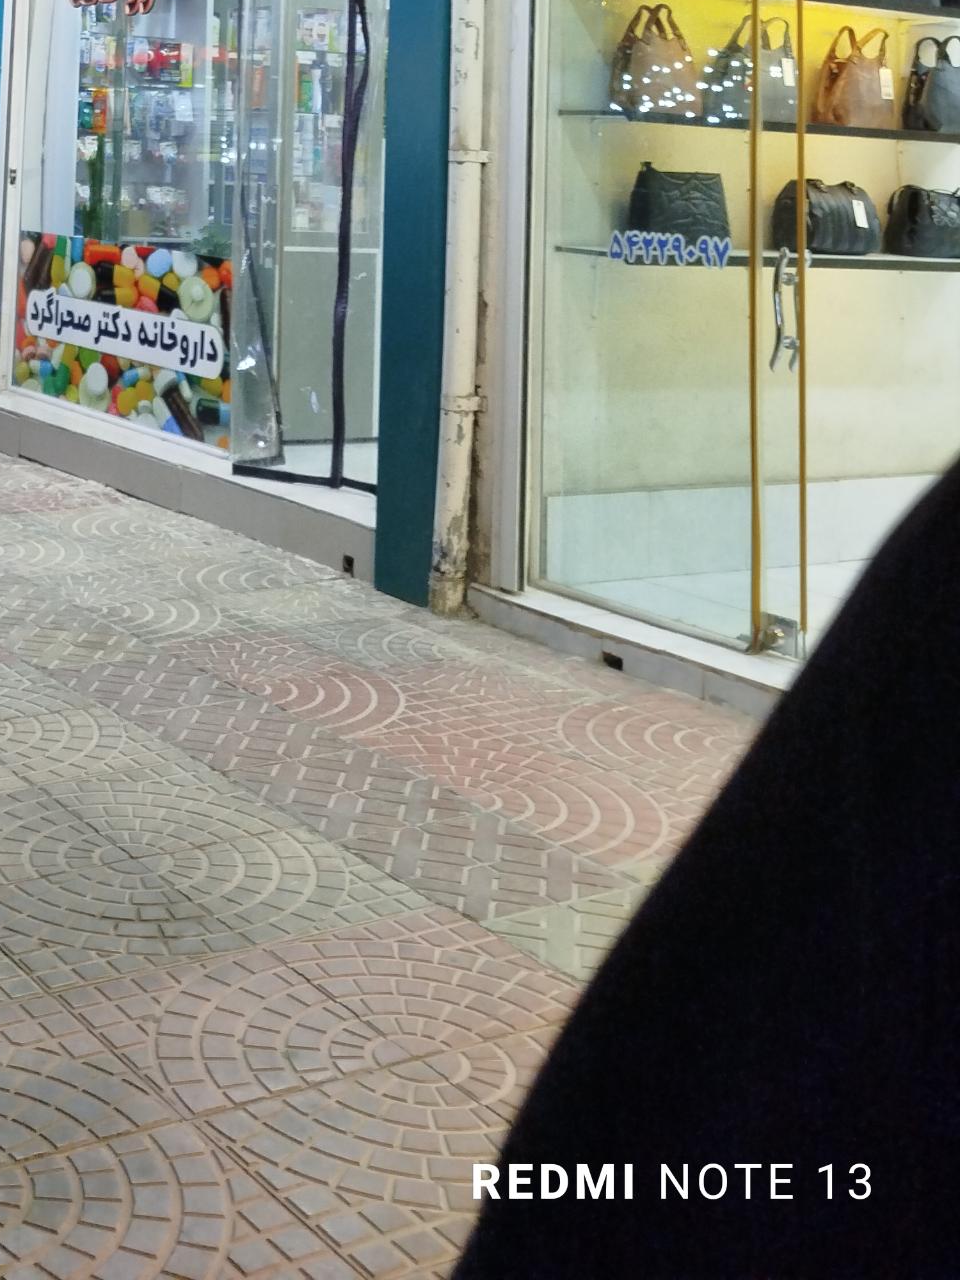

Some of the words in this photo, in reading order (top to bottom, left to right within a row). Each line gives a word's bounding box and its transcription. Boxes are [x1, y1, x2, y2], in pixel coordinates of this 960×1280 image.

[30, 292, 91, 336] صحراگرد
[94, 311, 132, 345] دکتر
[138, 320, 219, 368] داروخانه
